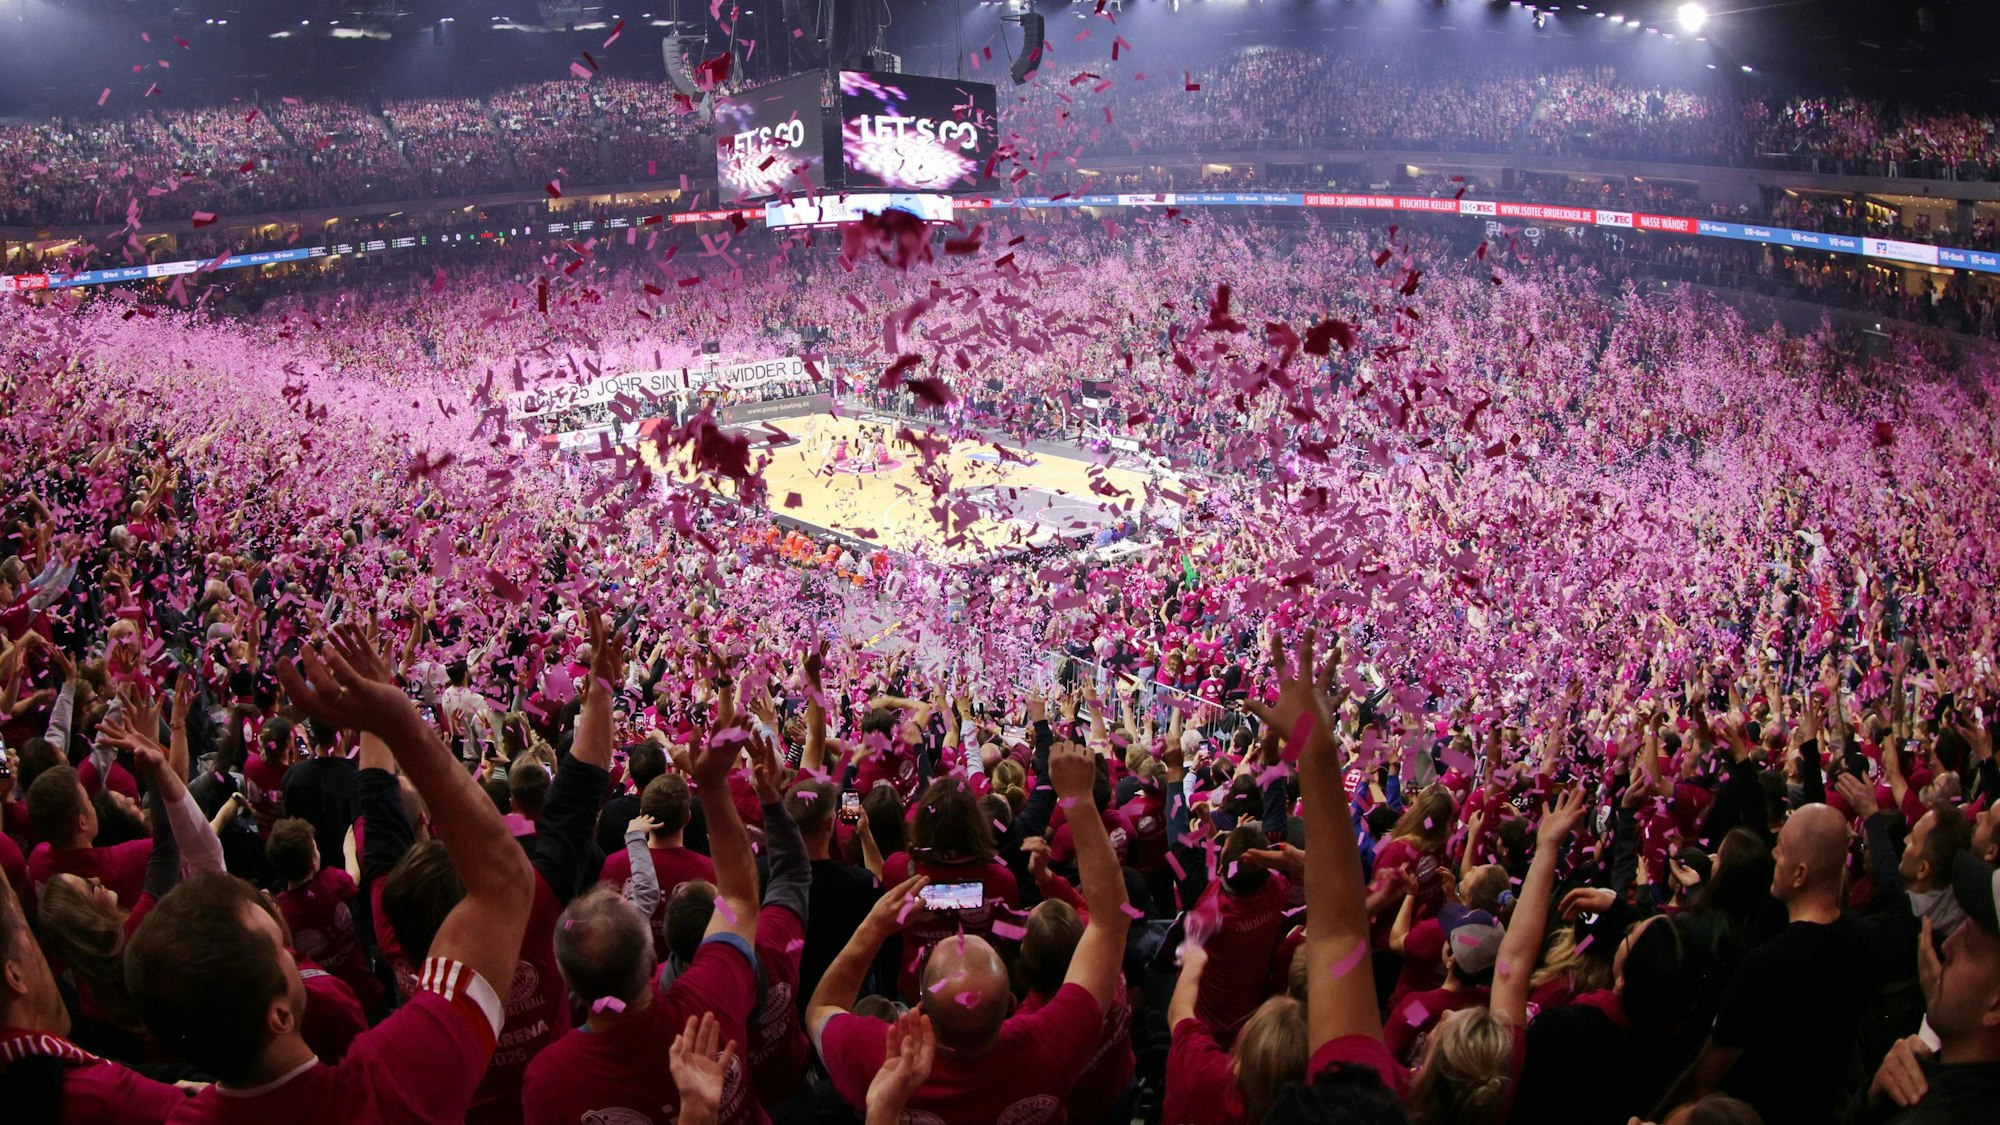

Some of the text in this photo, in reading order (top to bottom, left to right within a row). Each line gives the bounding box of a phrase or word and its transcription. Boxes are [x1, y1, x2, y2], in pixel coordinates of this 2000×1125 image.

[860, 114, 978, 150] LET'S GO
[727, 119, 804, 161] LET'S GO
[1307, 194, 1394, 207] SEIT ÜBER 20 JAHREN IN BONN
[1400, 199, 1456, 210] FEUCHTER KELLER?
[1461, 202, 1494, 212] ISOTEC
[1500, 205, 1592, 221] WWW.ISOTEC-BRUECKNER.DE
[1598, 214, 1630, 224] ISOTEC
[1641, 217, 1688, 231] NASSE WÄNDE?
[1700, 223, 1728, 232] VR-Bank
[1744, 228, 1770, 237] VR-Bank
[1791, 232, 1819, 243] VR-Bank
[1829, 237, 1855, 248] VR-Bank
[1940, 250, 1965, 262] VR-Bank
[1970, 254, 1996, 266] VR-Bank
[725, 362, 786, 384] WIDDER
[510, 390, 562, 412] NCH
[597, 377, 643, 396] JOHR
[651, 374, 677, 391] SIN
[746, 400, 810, 415] www.pinup-bowling.de
[497, 1019, 550, 1048] RENA
[491, 1048, 528, 1066] 025
